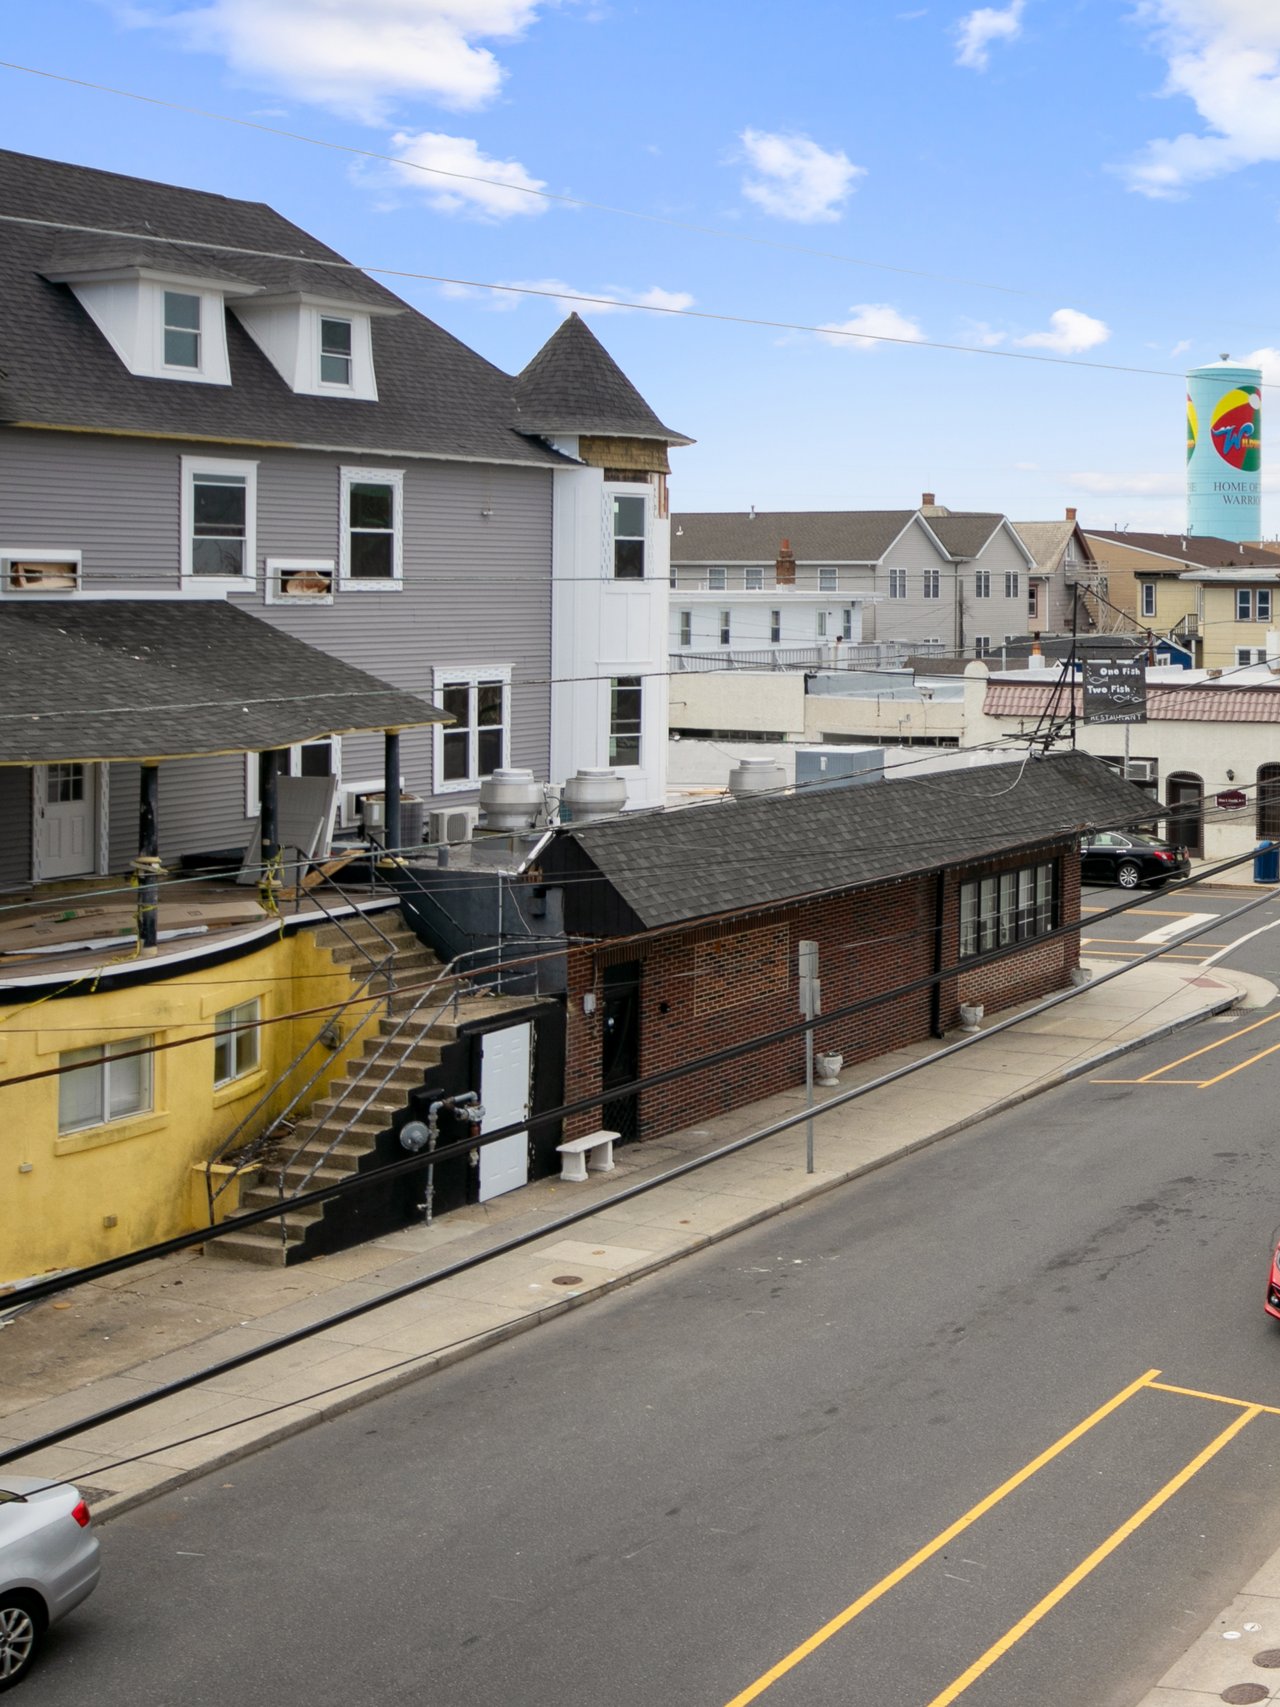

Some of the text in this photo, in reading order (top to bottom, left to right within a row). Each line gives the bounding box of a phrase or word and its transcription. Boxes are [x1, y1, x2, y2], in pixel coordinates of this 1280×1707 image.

[1214, 481, 1248, 492] HOME
[1087, 684, 1130, 693] Two Fish
